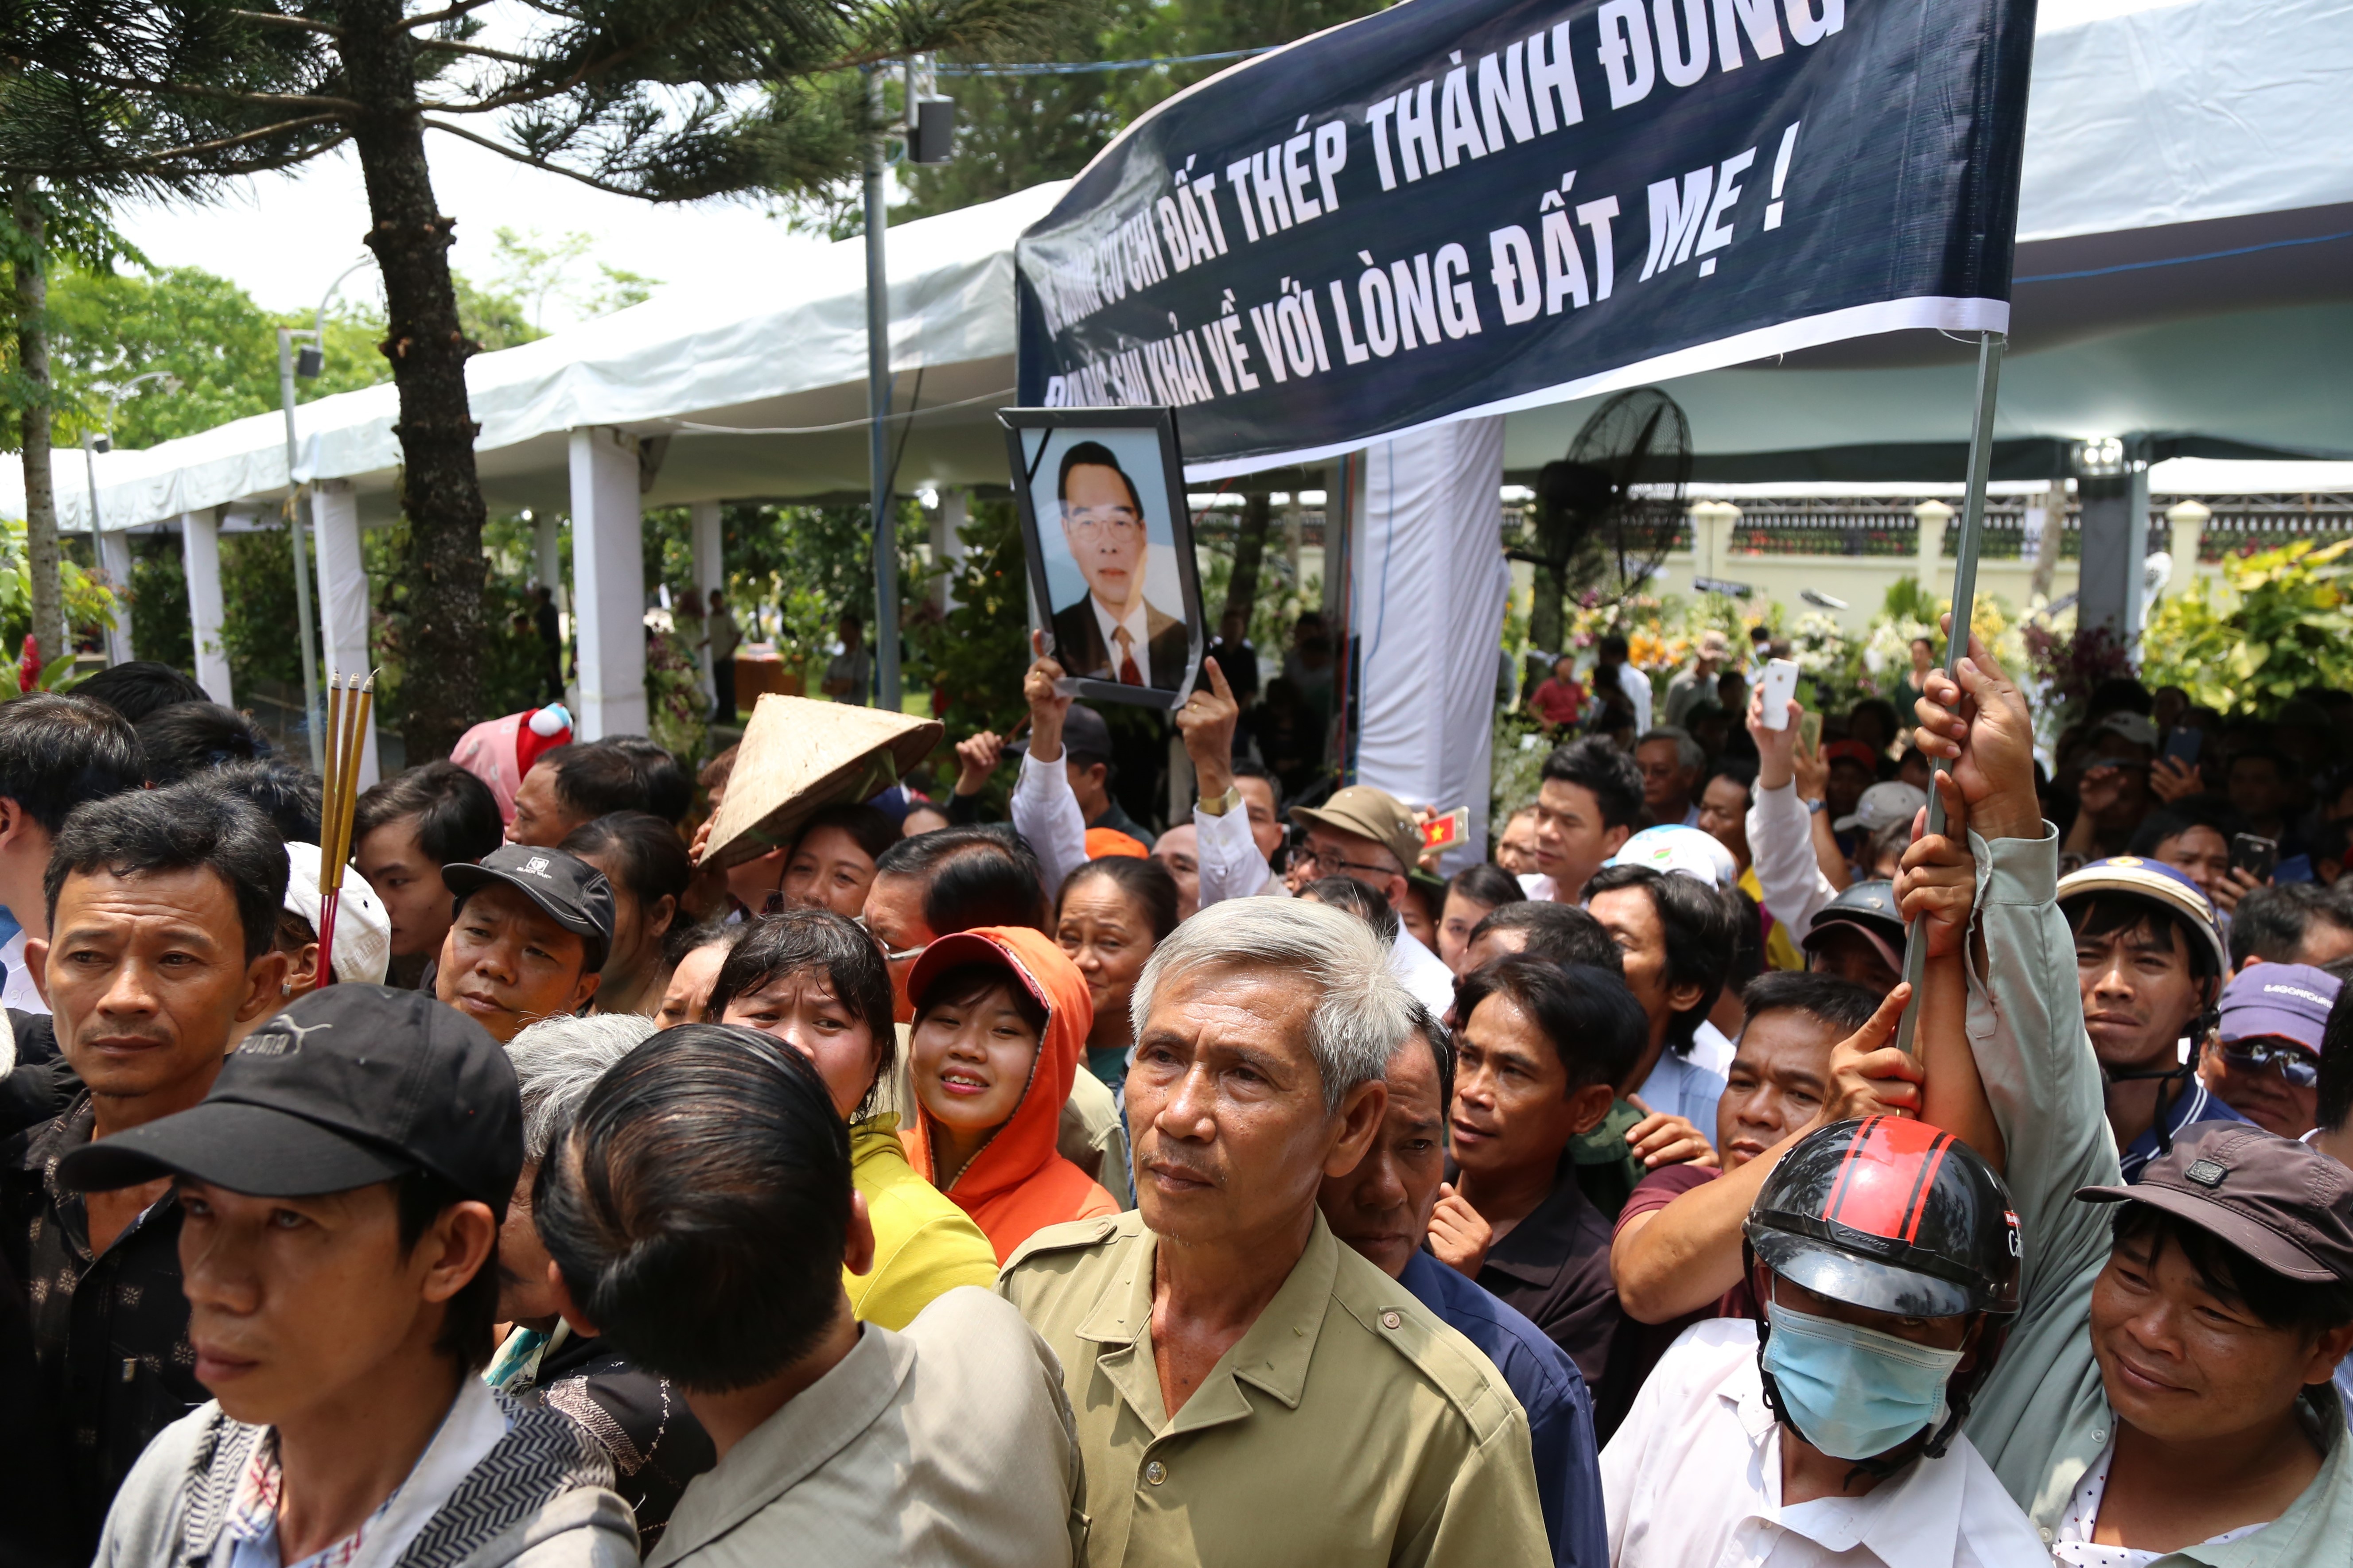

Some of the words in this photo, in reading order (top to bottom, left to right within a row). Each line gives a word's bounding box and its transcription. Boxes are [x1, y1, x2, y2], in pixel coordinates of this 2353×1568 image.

[1122, 207, 1168, 292] CHI
[1157, 154, 1229, 273] ĐẤT
[1226, 114, 1347, 243] THÉP
[1365, 19, 1583, 192] THÀNH
[1109, 337, 1152, 406] SÁU
[1144, 311, 1214, 408] KHẢI
[1202, 288, 1260, 395] VỀ
[1249, 276, 1330, 383] VỚI
[1330, 250, 1482, 365] LÒNG
[1489, 170, 1620, 326] ĐẤT
[1639, 146, 1757, 283] MẸ
[1763, 121, 1800, 232] !
[235, 1033, 290, 1056] PUMA
[2263, 984, 2334, 1009] SAIGONTOURIS
